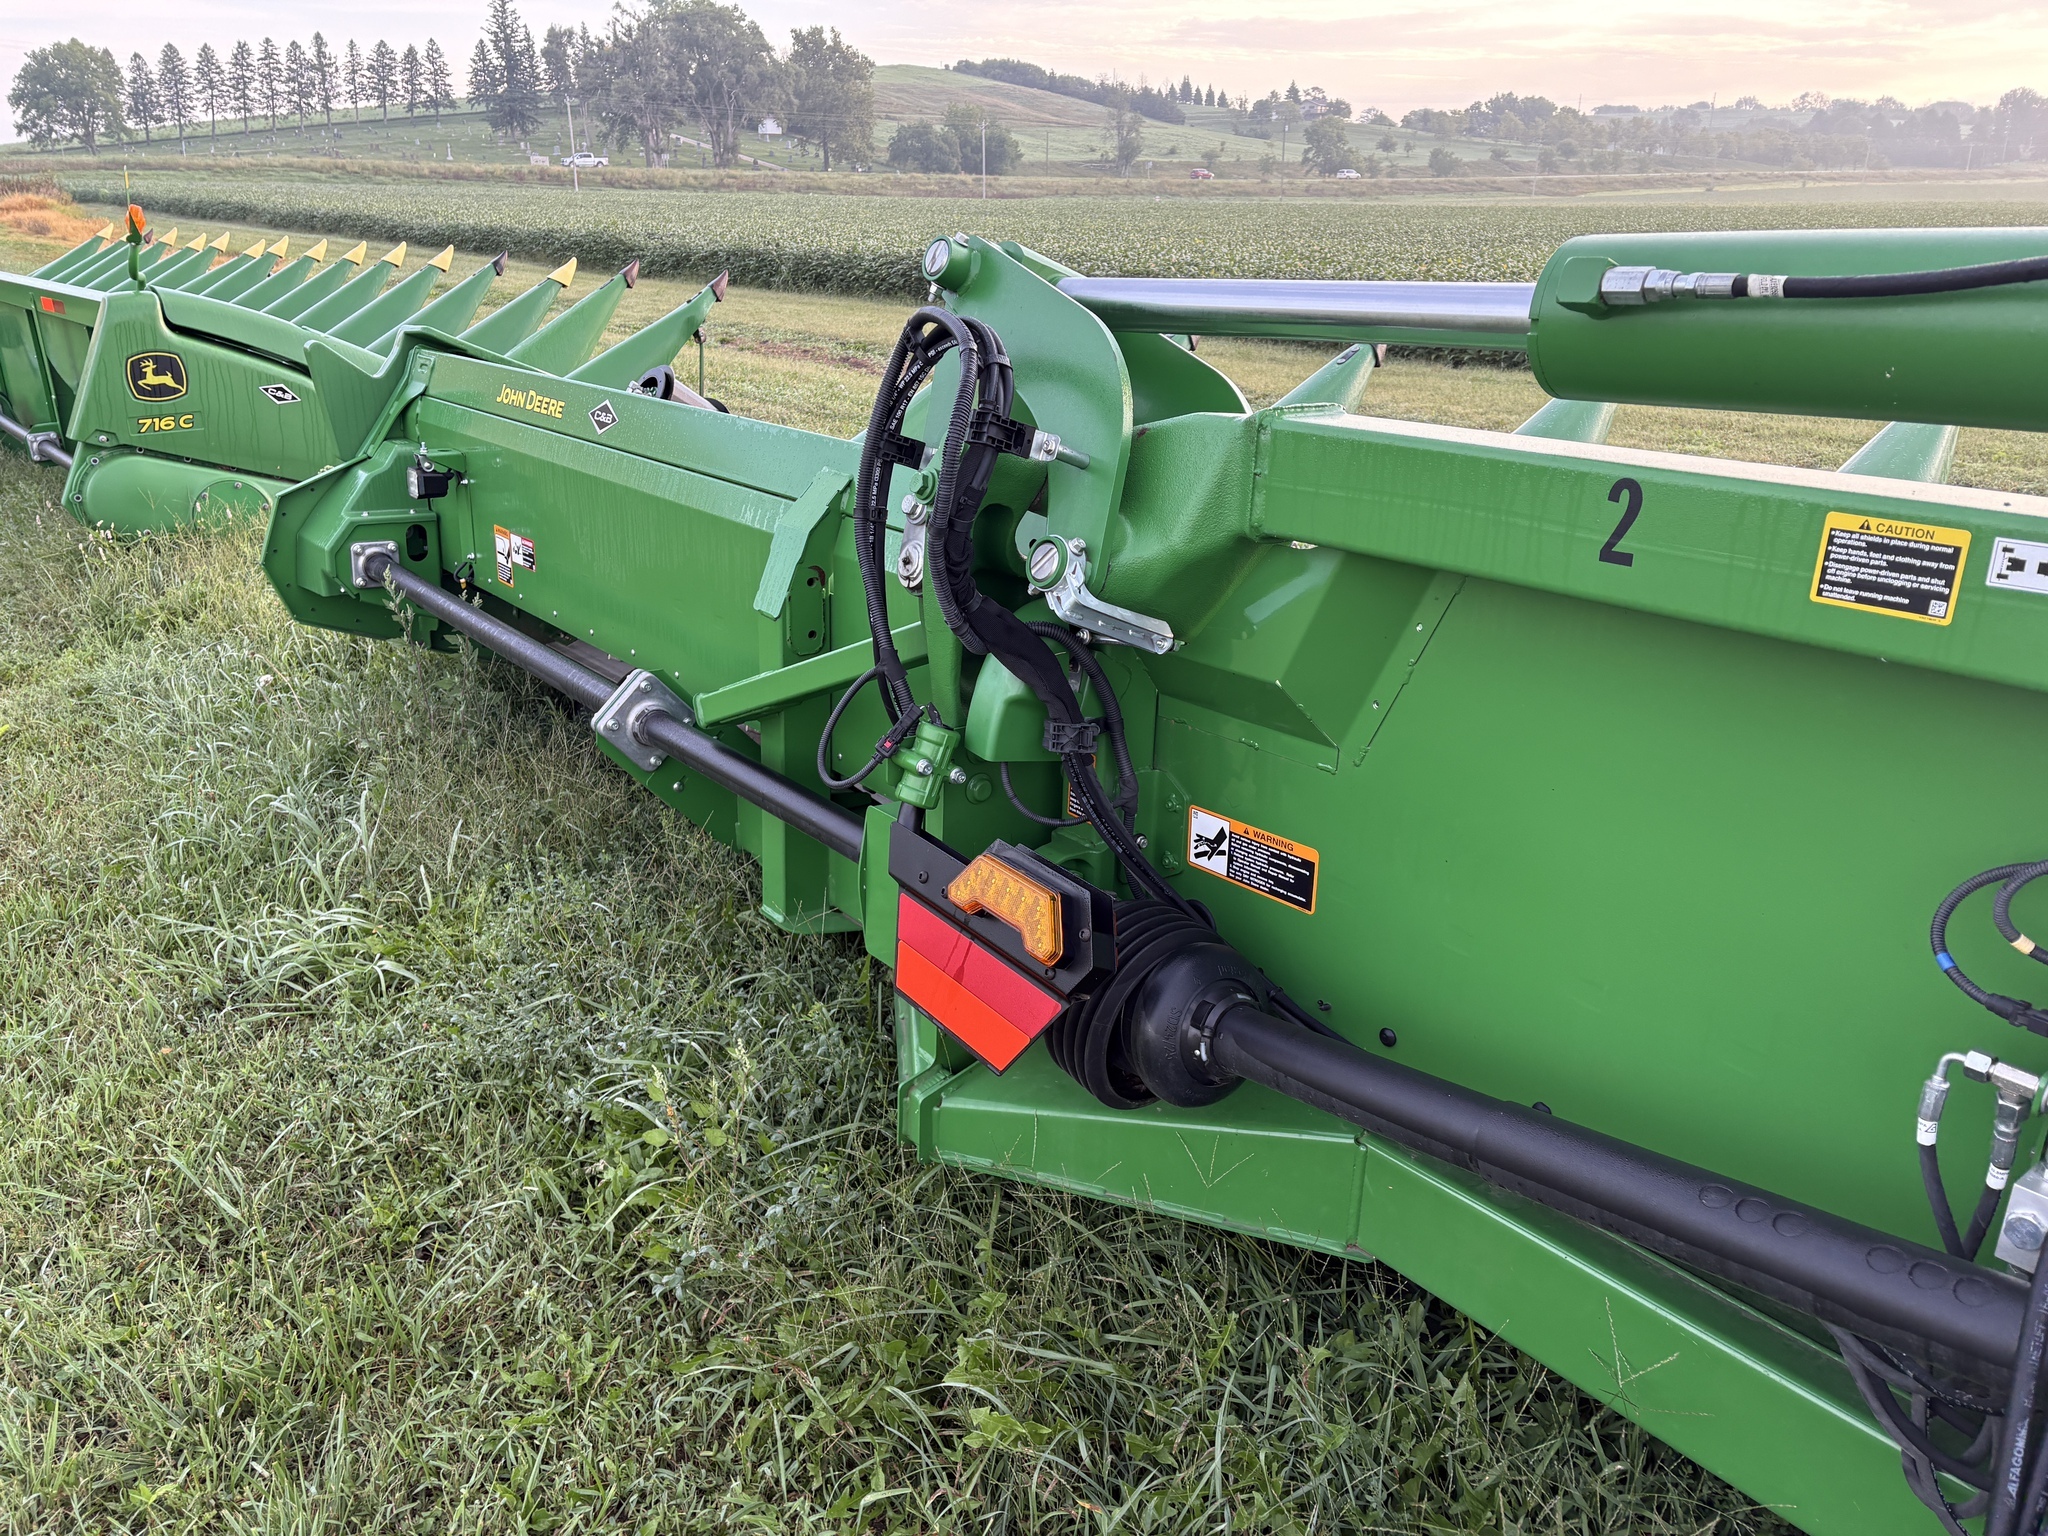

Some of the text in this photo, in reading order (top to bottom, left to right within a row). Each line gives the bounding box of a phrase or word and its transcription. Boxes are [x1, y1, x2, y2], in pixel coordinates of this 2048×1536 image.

[911, 363, 921, 374] MPa
[267, 387, 293, 401] C&B
[496, 383, 566, 419] JOHN DEERE
[137, 414, 194, 434] 716 C
[594, 410, 613, 424] C&B
[889, 418, 898, 431] SAE
[899, 399, 908, 411] R17
[1599, 477, 1643, 568] 2
[1877, 523, 1935, 539] CAUTION
[1833, 538, 1867, 547] operations.
[1835, 530, 1851, 539] Keep
[1860, 534, 1882, 543] shields
[1908, 541, 1930, 551] during
[1930, 545, 1954, 553] normal
[1831, 546, 1847, 554] Keep
[1869, 551, 1882, 559] feet
[1895, 556, 1921, 566] clothing
[1922, 561, 1939, 569] away
[1939, 562, 1955, 570] from
[1825, 575, 1852, 583] machine.
[1828, 561, 1860, 573] Disengage
[1900, 574, 1917, 583] parts
[1836, 570, 1857, 578] engine
[1857, 572, 1877, 581] before
[1877, 577, 1912, 588] unclogging
[1920, 584, 1950, 595] servicing
[1843, 587, 1859, 595] leave
[1859, 591, 1883, 601] running
[1883, 595, 1909, 604] machine
[1252, 829, 1294, 852] WARNING
